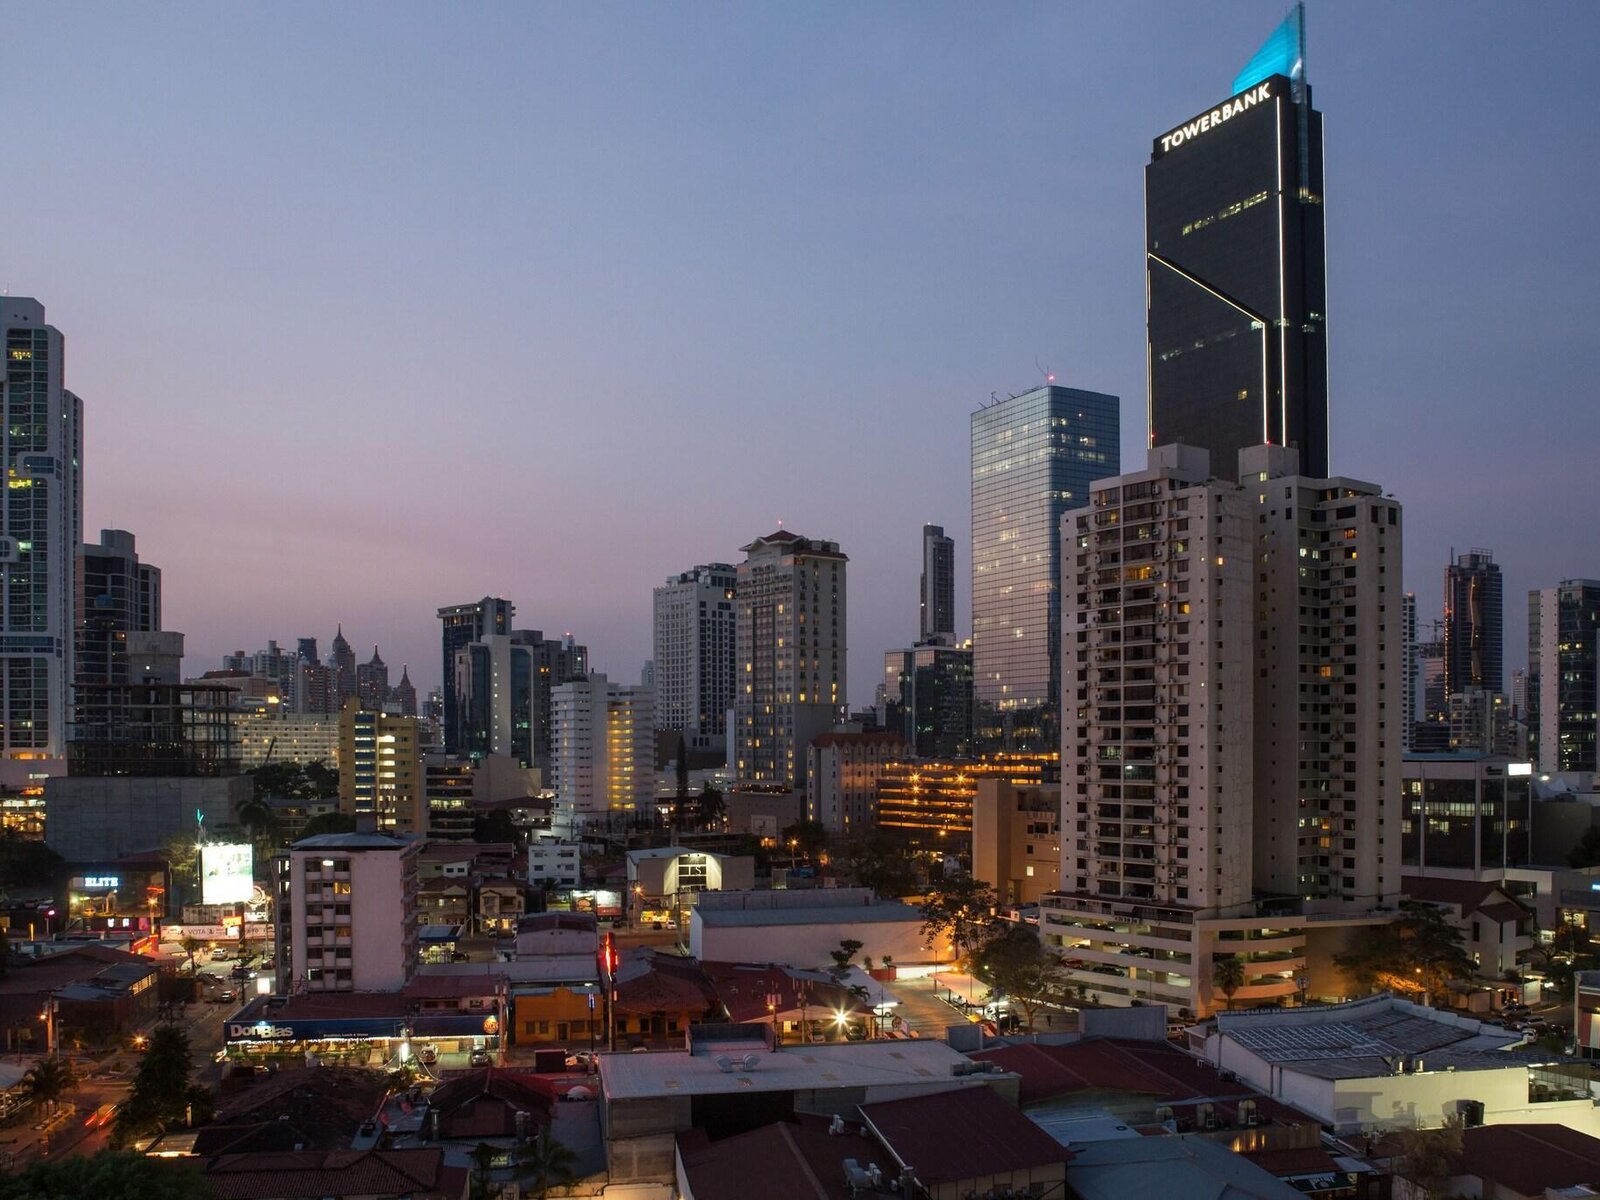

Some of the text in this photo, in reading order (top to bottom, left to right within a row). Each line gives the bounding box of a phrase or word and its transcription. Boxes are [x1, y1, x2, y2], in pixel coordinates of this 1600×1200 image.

[1161, 82, 1271, 152] TOWERBANK
[84, 877, 119, 887] ELITE
[187, 928, 206, 936] VOTA
